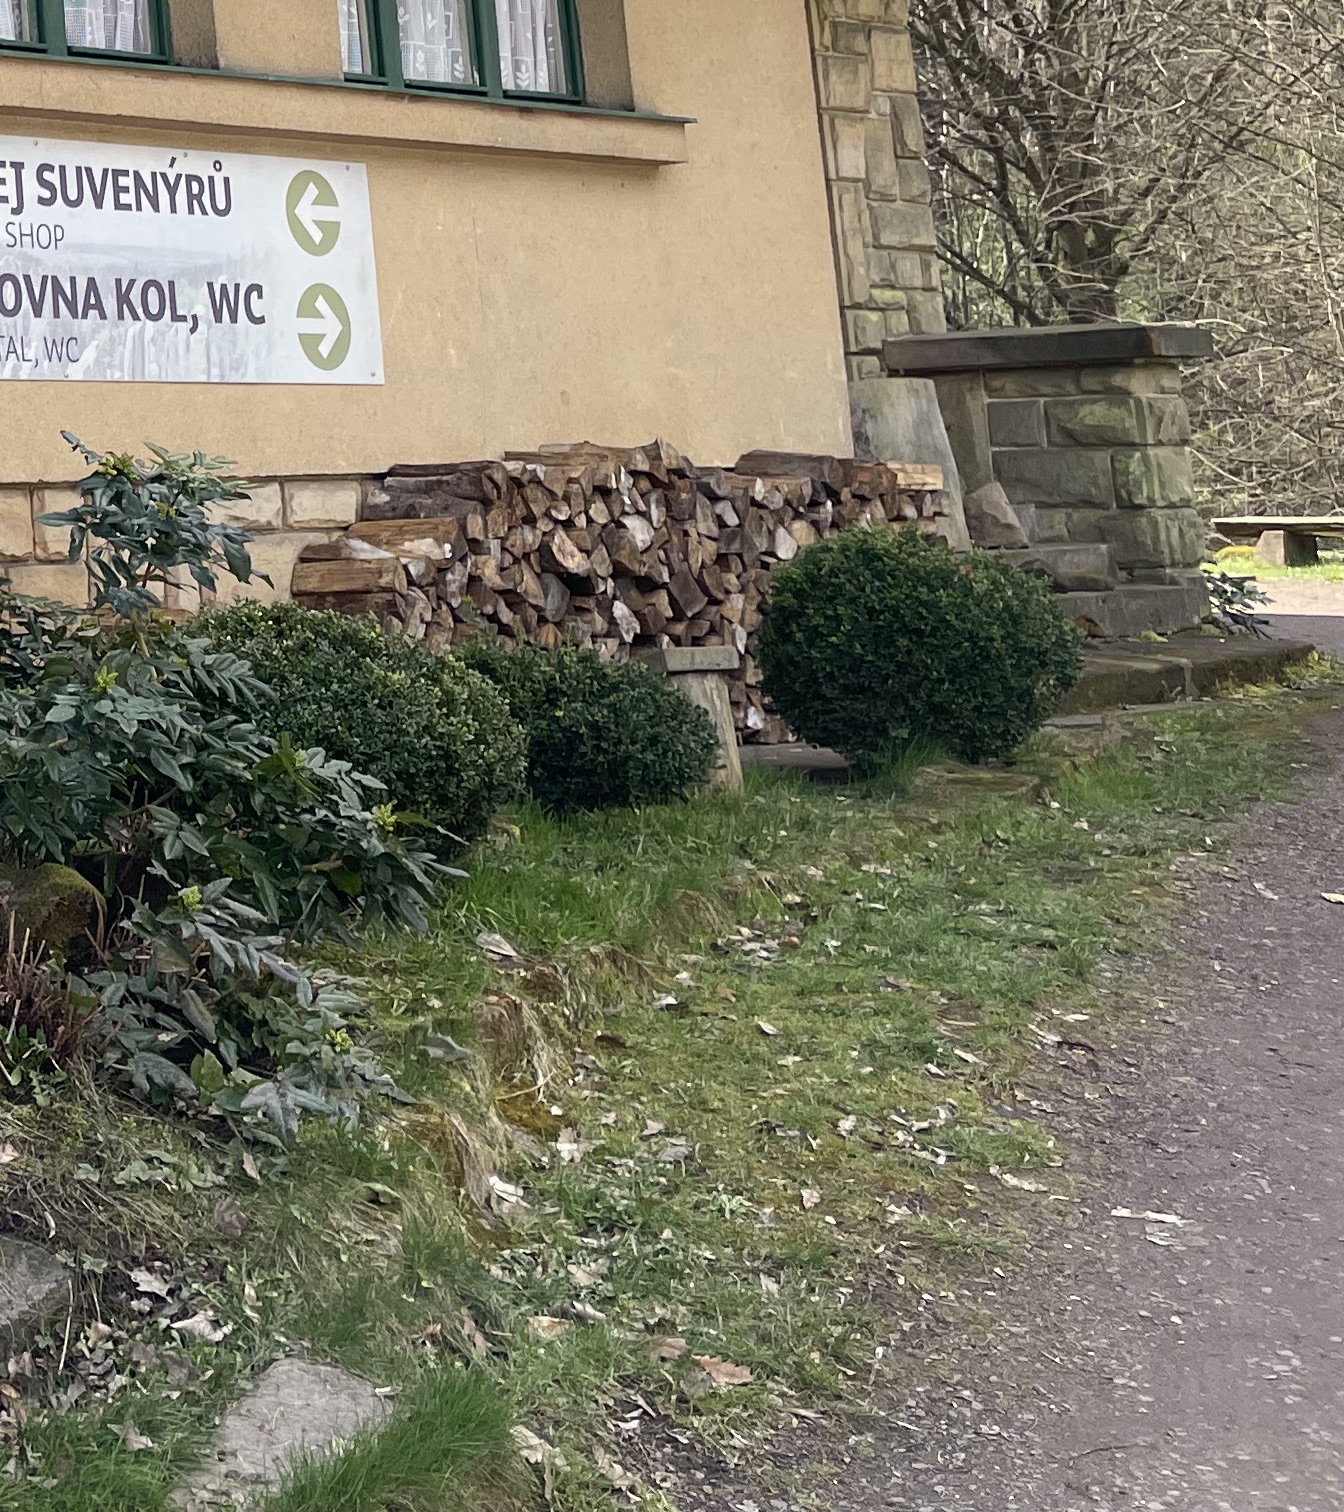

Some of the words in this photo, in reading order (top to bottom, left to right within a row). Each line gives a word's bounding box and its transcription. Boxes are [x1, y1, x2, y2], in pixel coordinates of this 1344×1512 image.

[35, 156, 232, 218] SUVENÝRŮ
[6, 221, 65, 251] SHOP
[115, 277, 200, 336] KOL,
[206, 281, 266, 326] WC
[43, 336, 81, 364] WC
